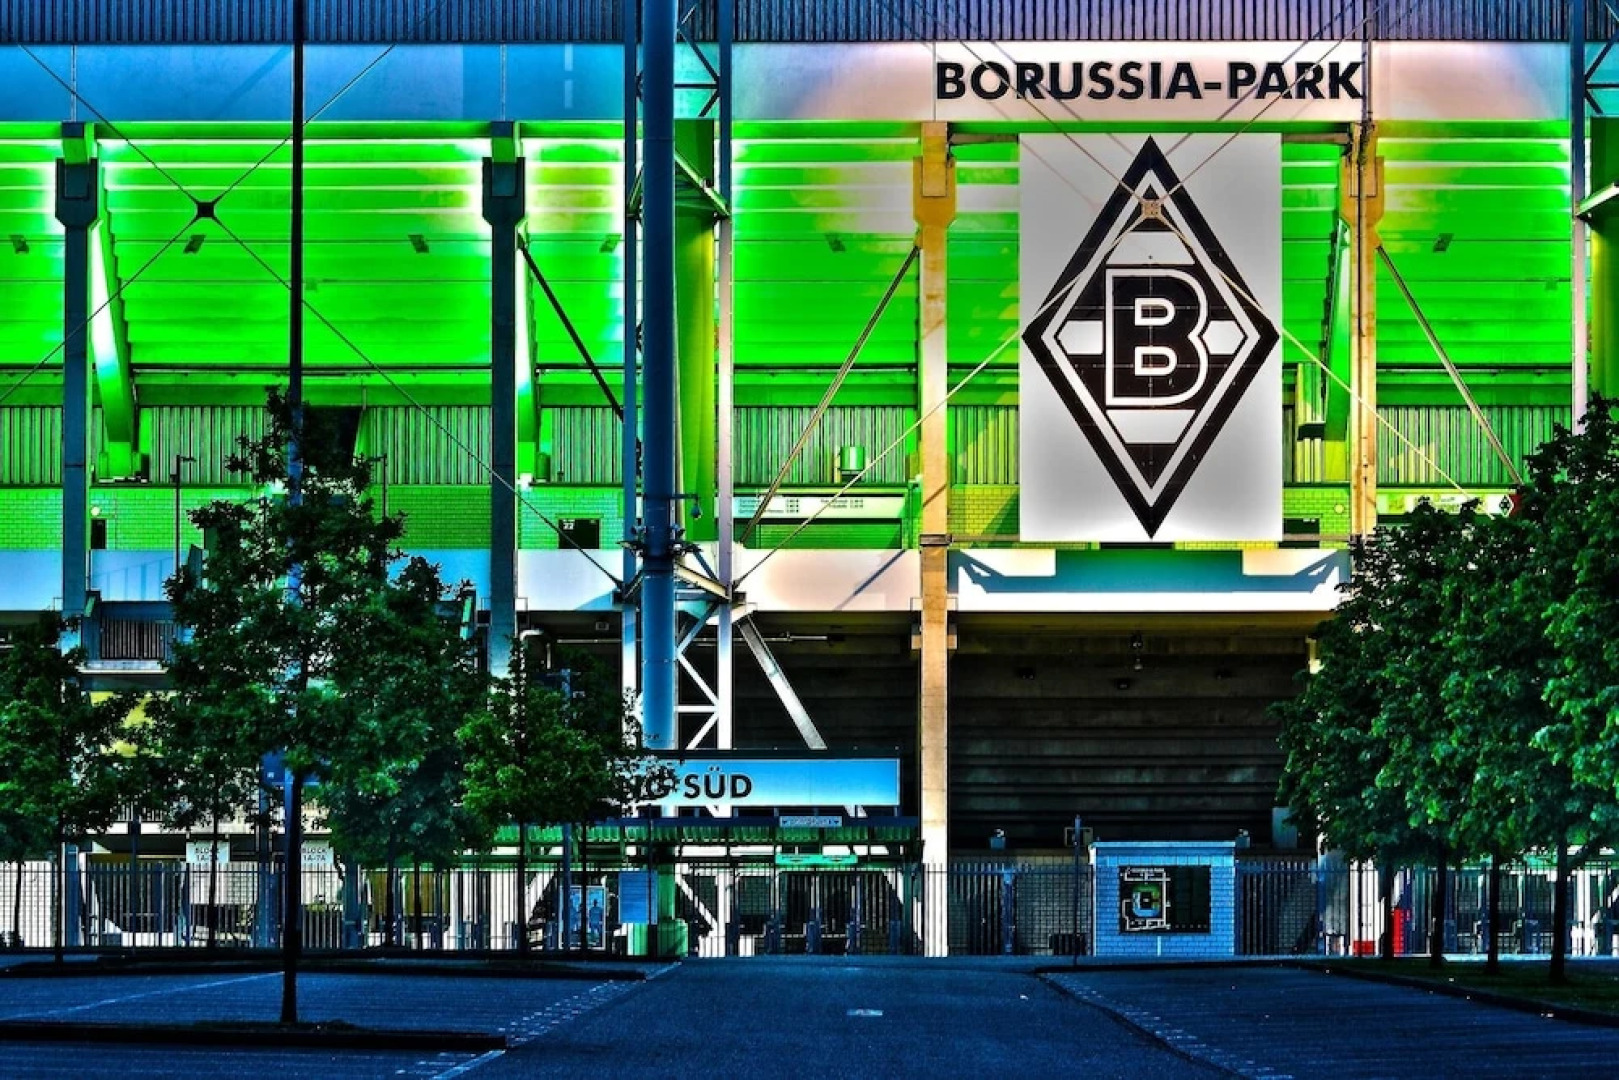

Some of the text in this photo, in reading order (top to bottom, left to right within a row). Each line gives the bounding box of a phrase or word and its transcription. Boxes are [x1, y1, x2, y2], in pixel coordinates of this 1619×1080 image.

[936, 61, 1364, 100] BORUSSIA-PARK
[1105, 268, 1209, 407] B
[683, 766, 752, 799] SÜD
